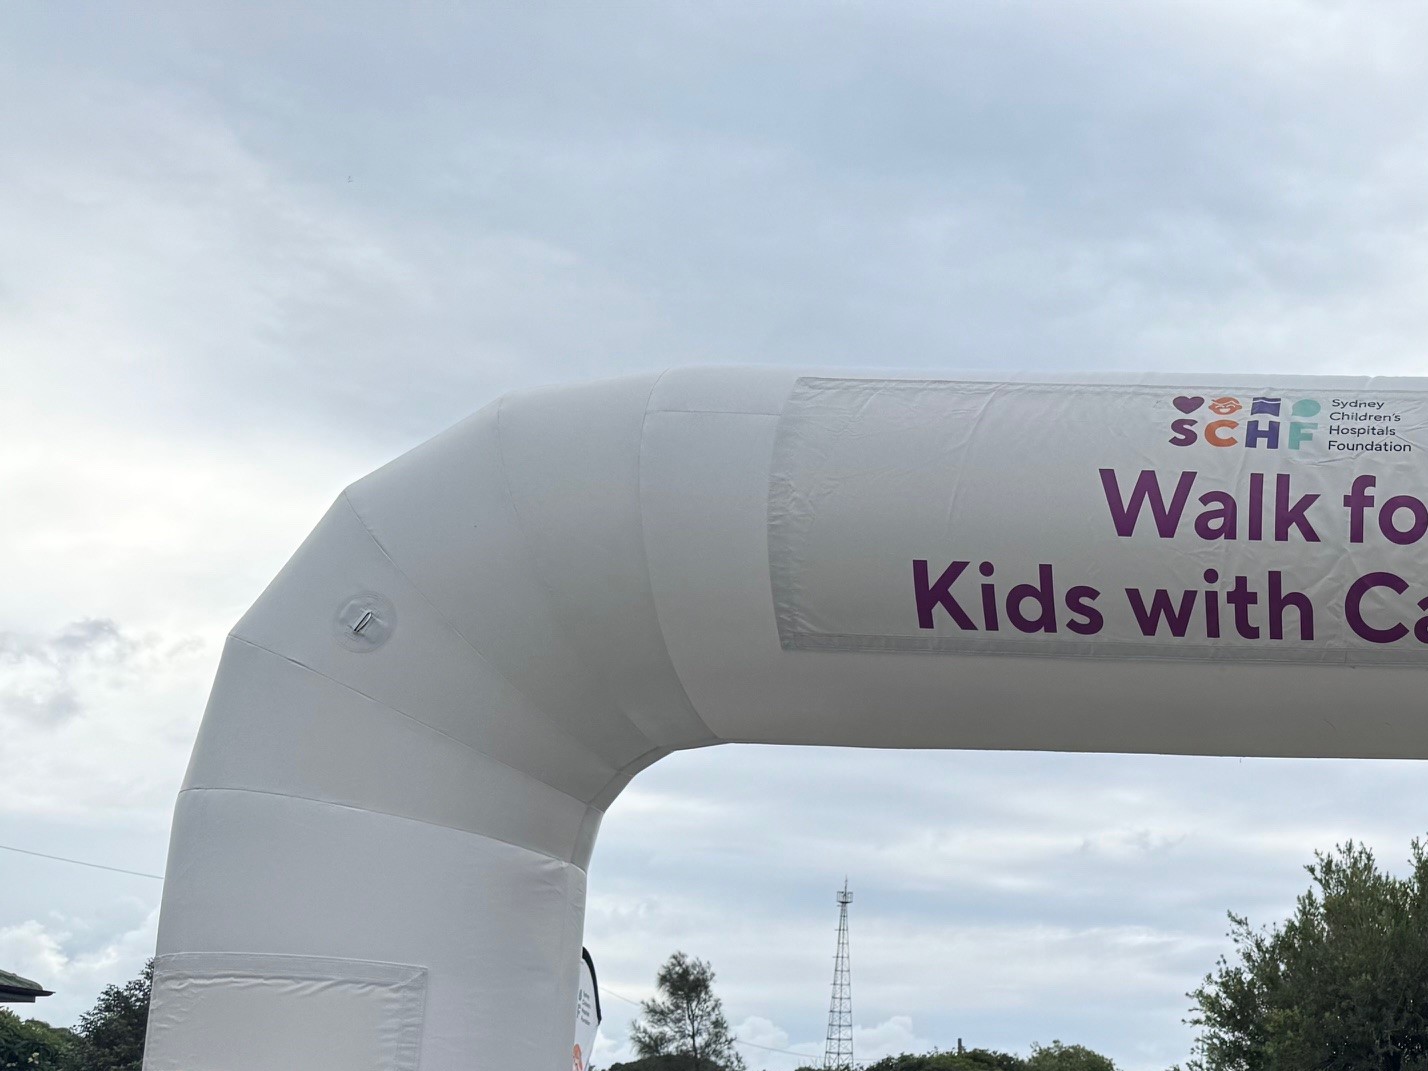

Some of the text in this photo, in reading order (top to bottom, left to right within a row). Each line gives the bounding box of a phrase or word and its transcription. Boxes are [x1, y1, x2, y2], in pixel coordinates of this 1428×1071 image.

[1332, 398, 1385, 410] Sydney
[1329, 411, 1401, 422] Children's
[1168, 418, 1319, 450] SCHF
[1329, 425, 1396, 437] Hospitals
[1328, 440, 1412, 452] Foundation
[1098, 468, 1321, 543] Walk
[912, 559, 1104, 636] Kids
[1124, 567, 1314, 641] with
